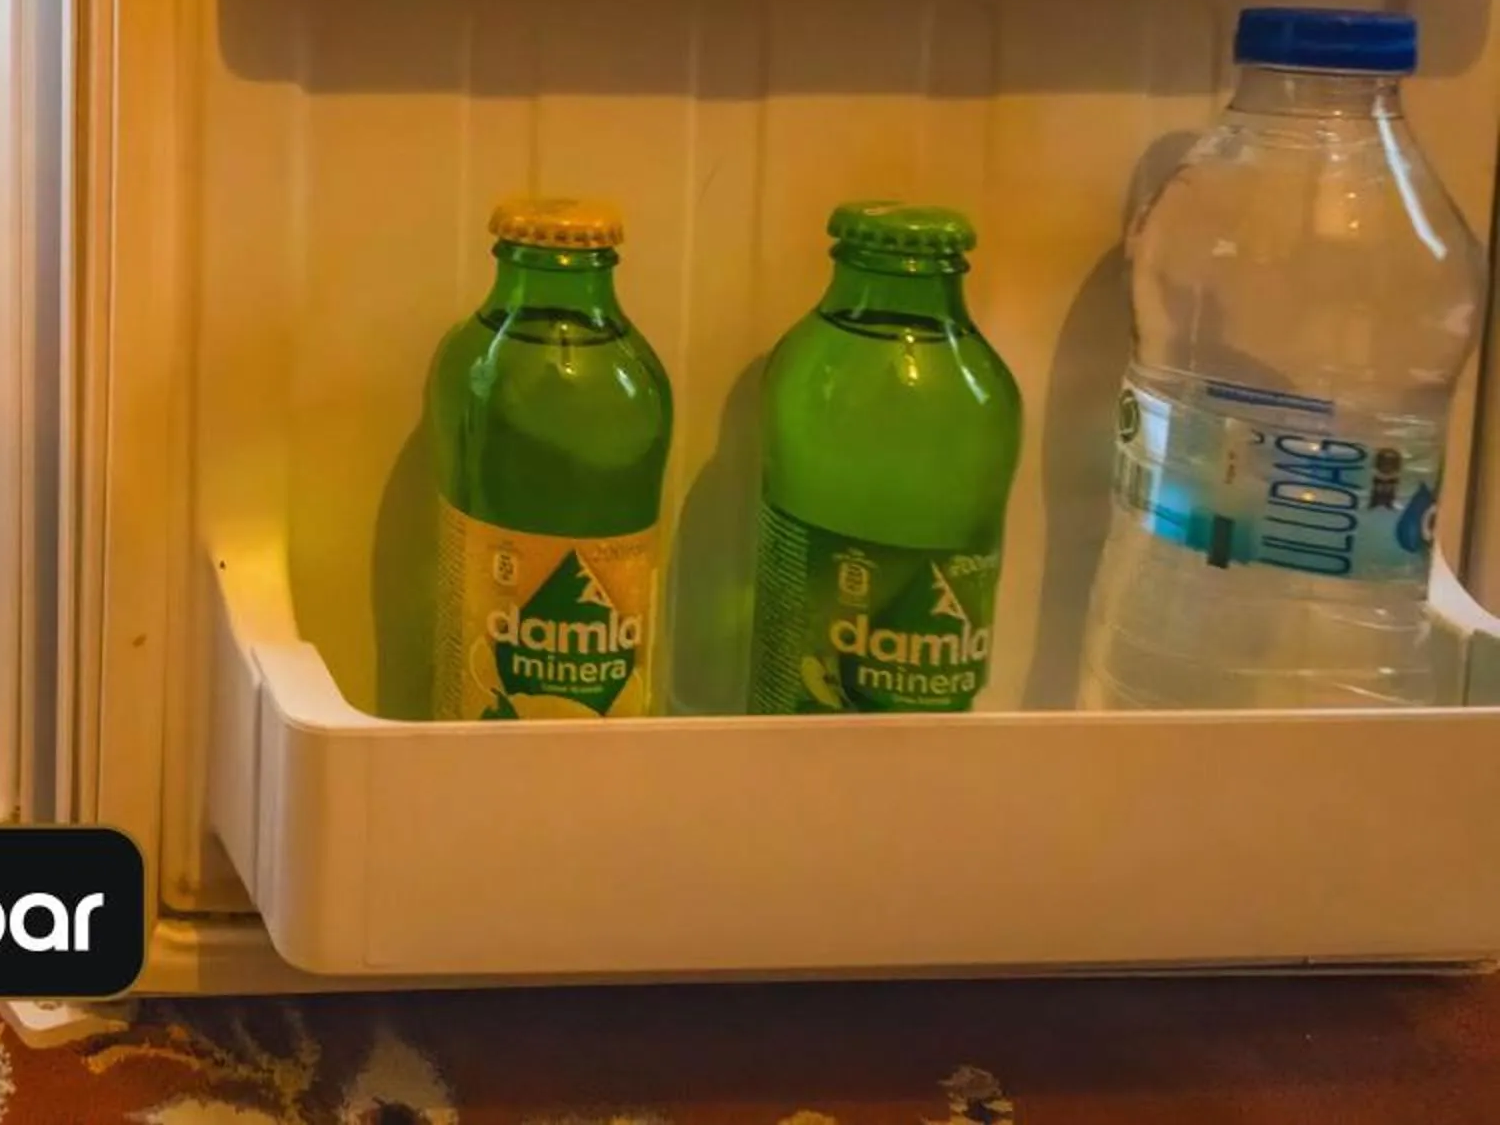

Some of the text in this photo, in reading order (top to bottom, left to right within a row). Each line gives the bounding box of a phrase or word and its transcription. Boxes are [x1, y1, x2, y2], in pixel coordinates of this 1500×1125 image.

[1252, 429, 1369, 576] ULUDAĞ
[486, 603, 642, 655] damla
[829, 613, 991, 667] damla
[512, 653, 628, 683] minera
[856, 664, 976, 695] minera
